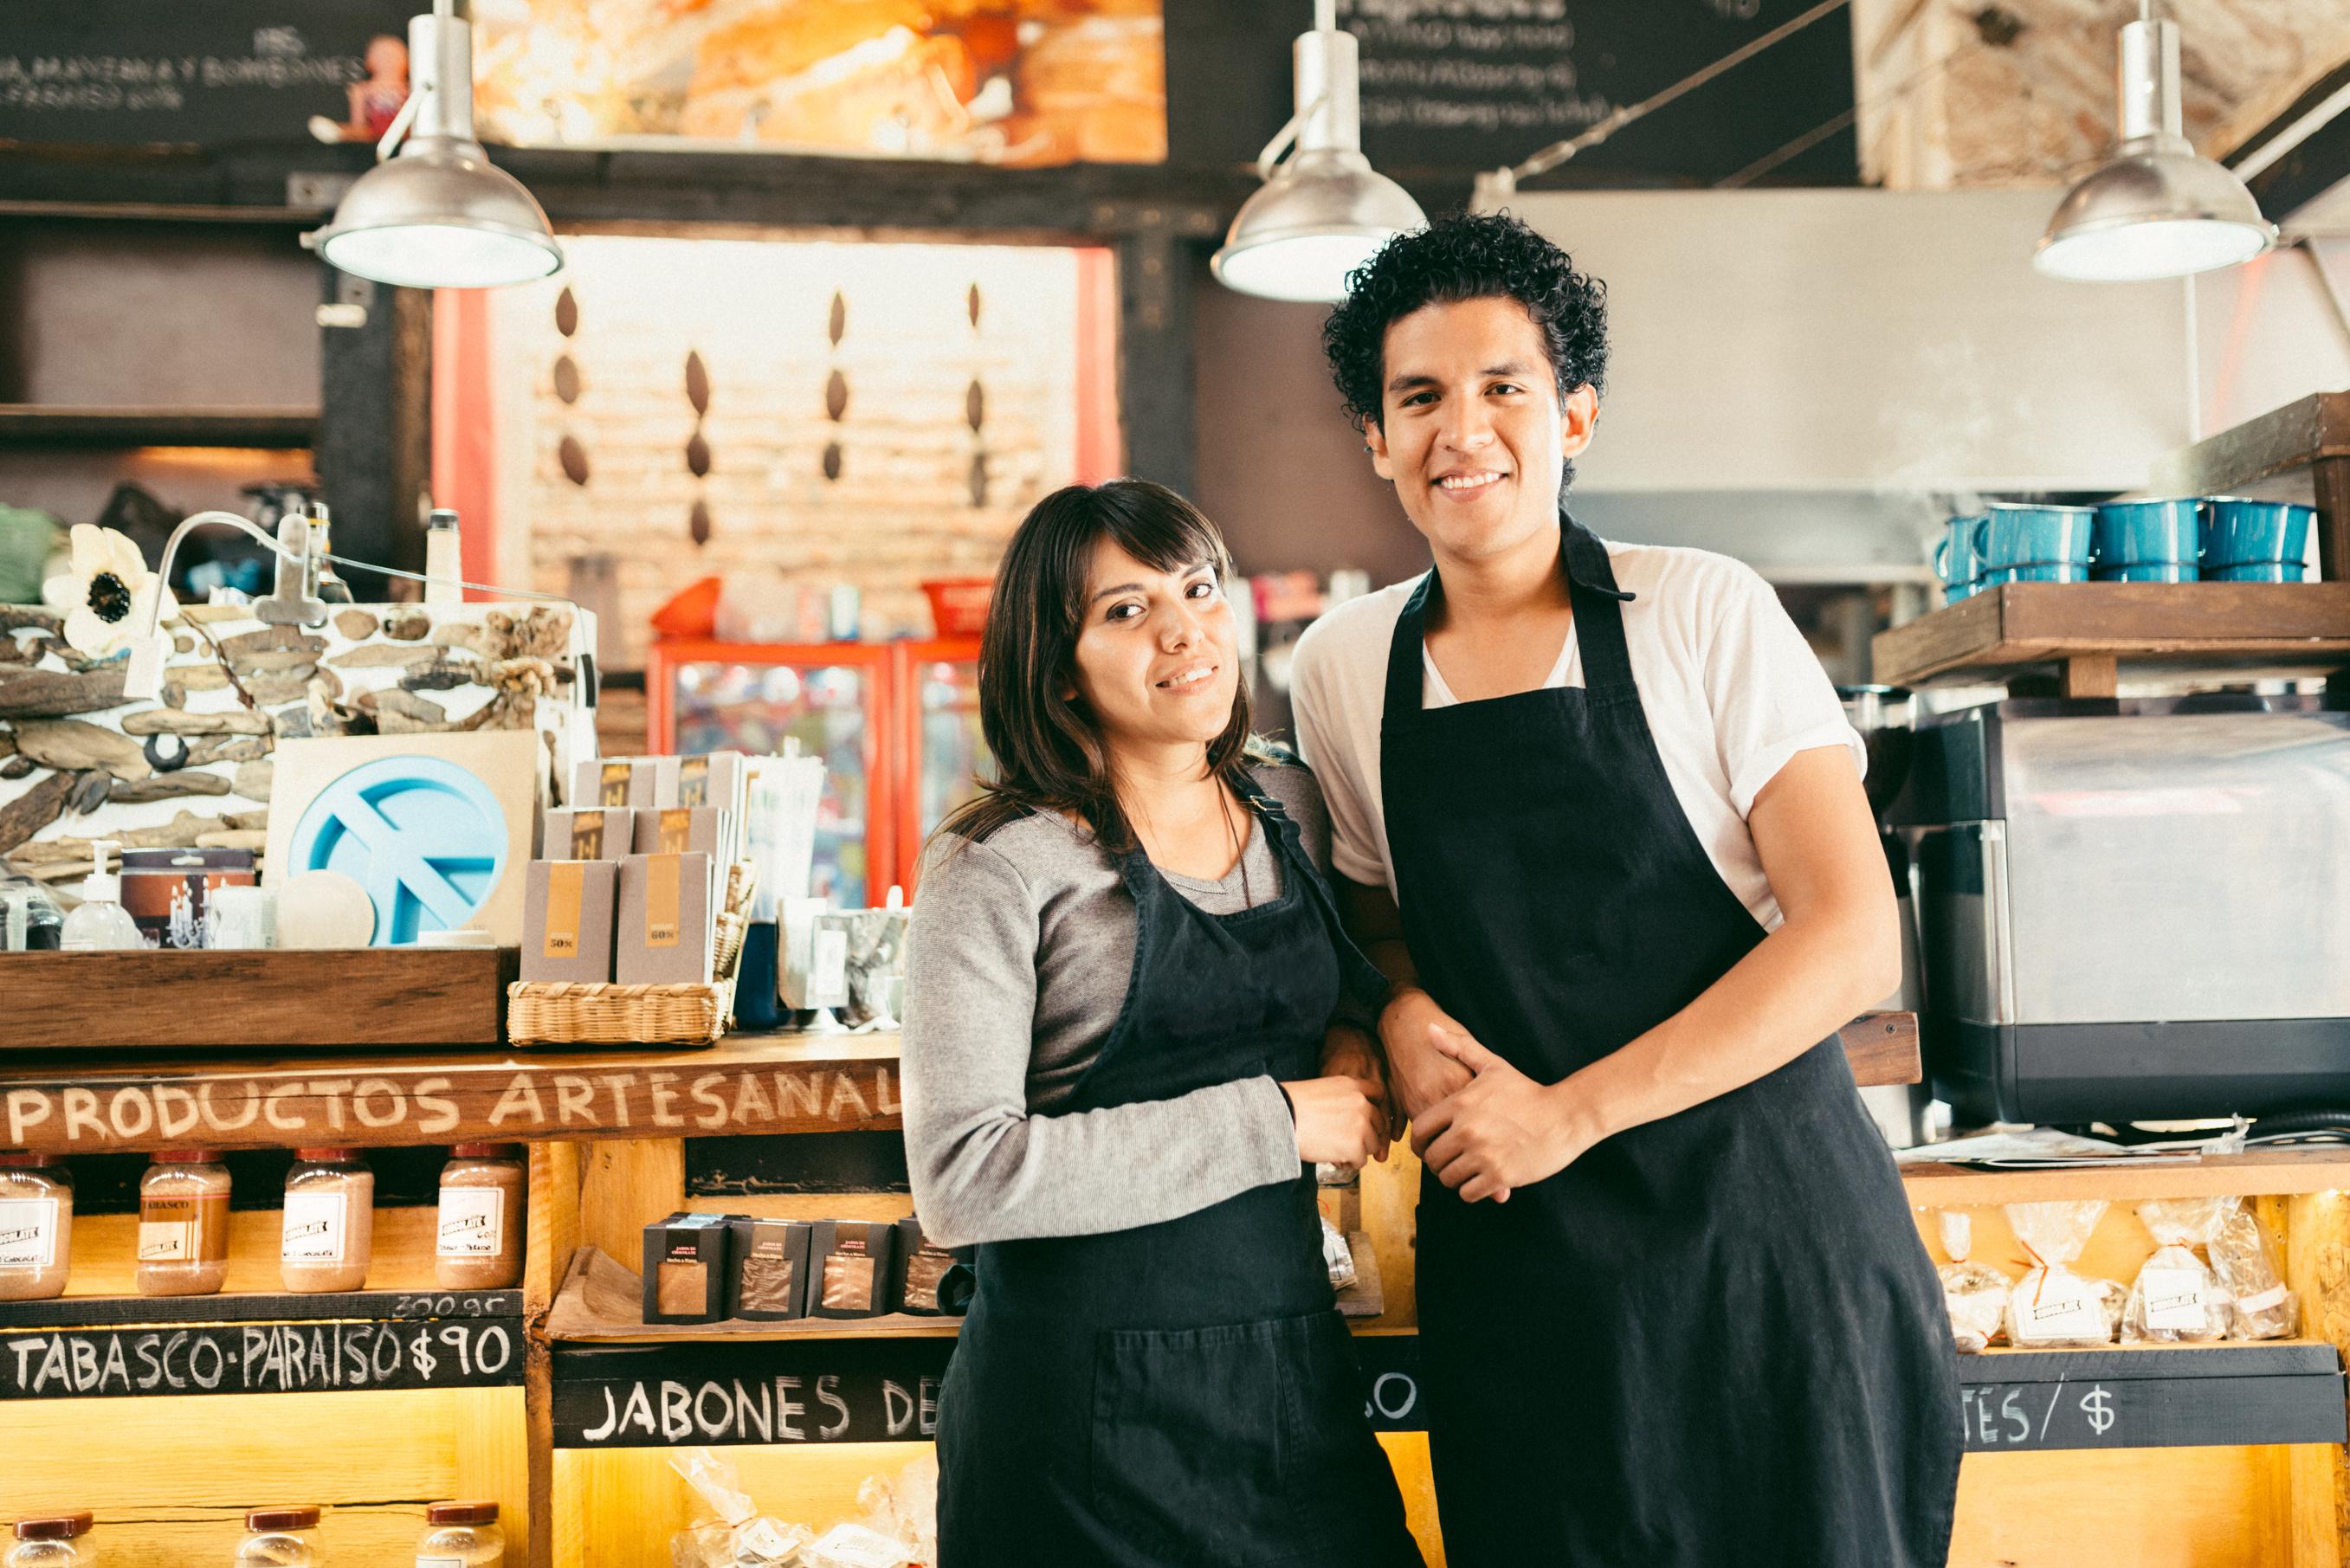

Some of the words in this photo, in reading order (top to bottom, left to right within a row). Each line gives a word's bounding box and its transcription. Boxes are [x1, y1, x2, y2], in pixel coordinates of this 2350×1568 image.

[7, 1077, 461, 1145] PRODUCTOS
[487, 1065, 901, 1130] ARTESANAL
[410, 1325, 511, 1381] $90
[583, 1375, 850, 1442] JABONES
[882, 1375, 939, 1436] DE
